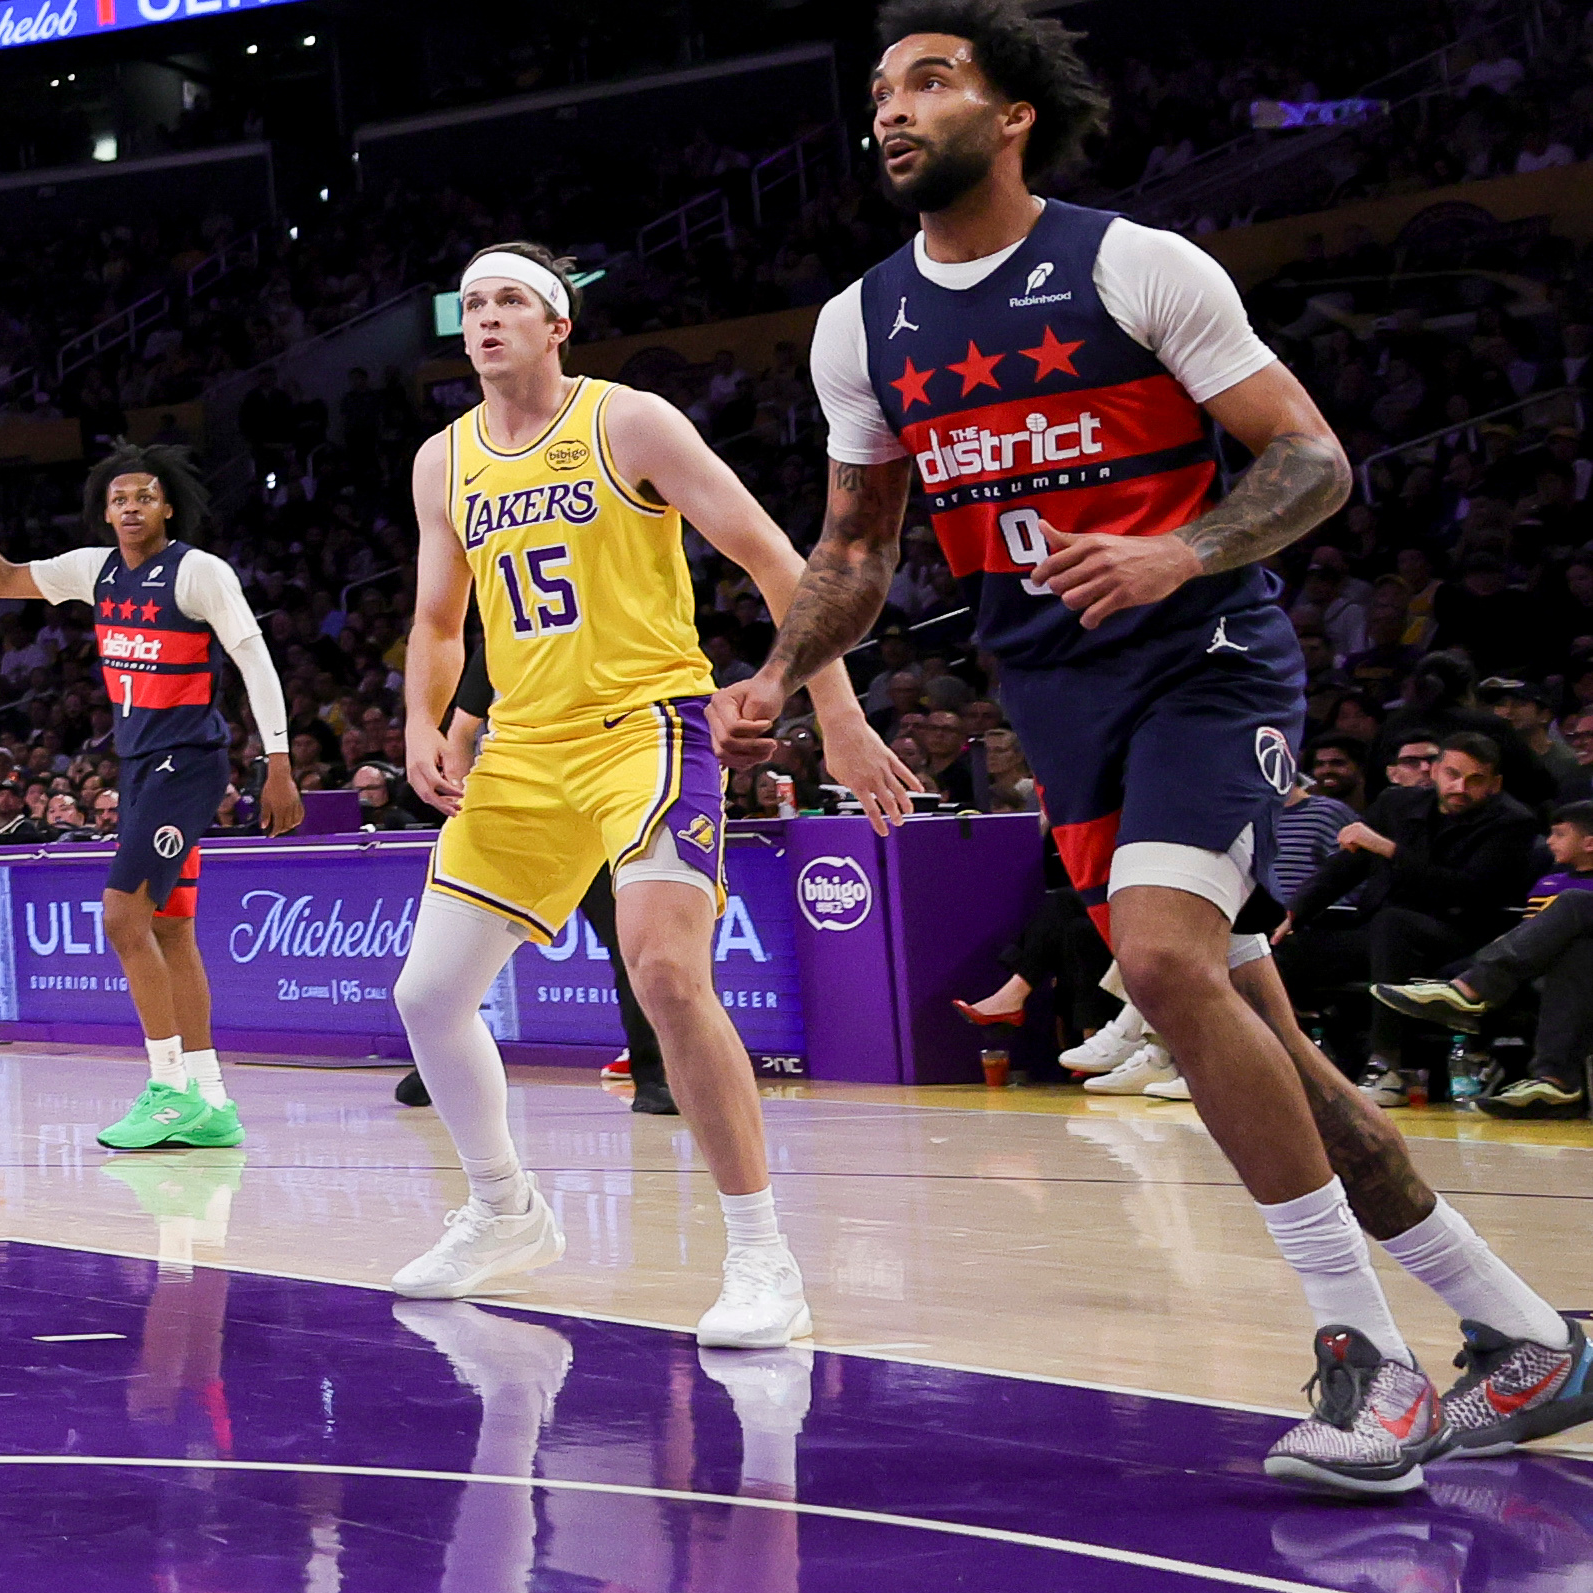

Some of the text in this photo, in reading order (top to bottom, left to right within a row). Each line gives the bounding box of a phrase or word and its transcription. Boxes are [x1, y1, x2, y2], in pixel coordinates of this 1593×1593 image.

[1009, 289, 1072, 308] Robinhood
[916, 411, 1103, 485] district
[948, 425, 979, 443] THE
[548, 448, 587, 462] bibigo
[465, 478, 602, 551] LAKERS
[998, 508, 1055, 596] 9
[497, 541, 583, 640] 15
[804, 876, 867, 909] bibigo
[25, 900, 107, 957] ULT
[229, 889, 415, 964] Michelob
[29, 974, 99, 991] SUPERIOR
[277, 979, 300, 1001] 26
[340, 980, 362, 1003] 95
[722, 990, 778, 1008] BEER
